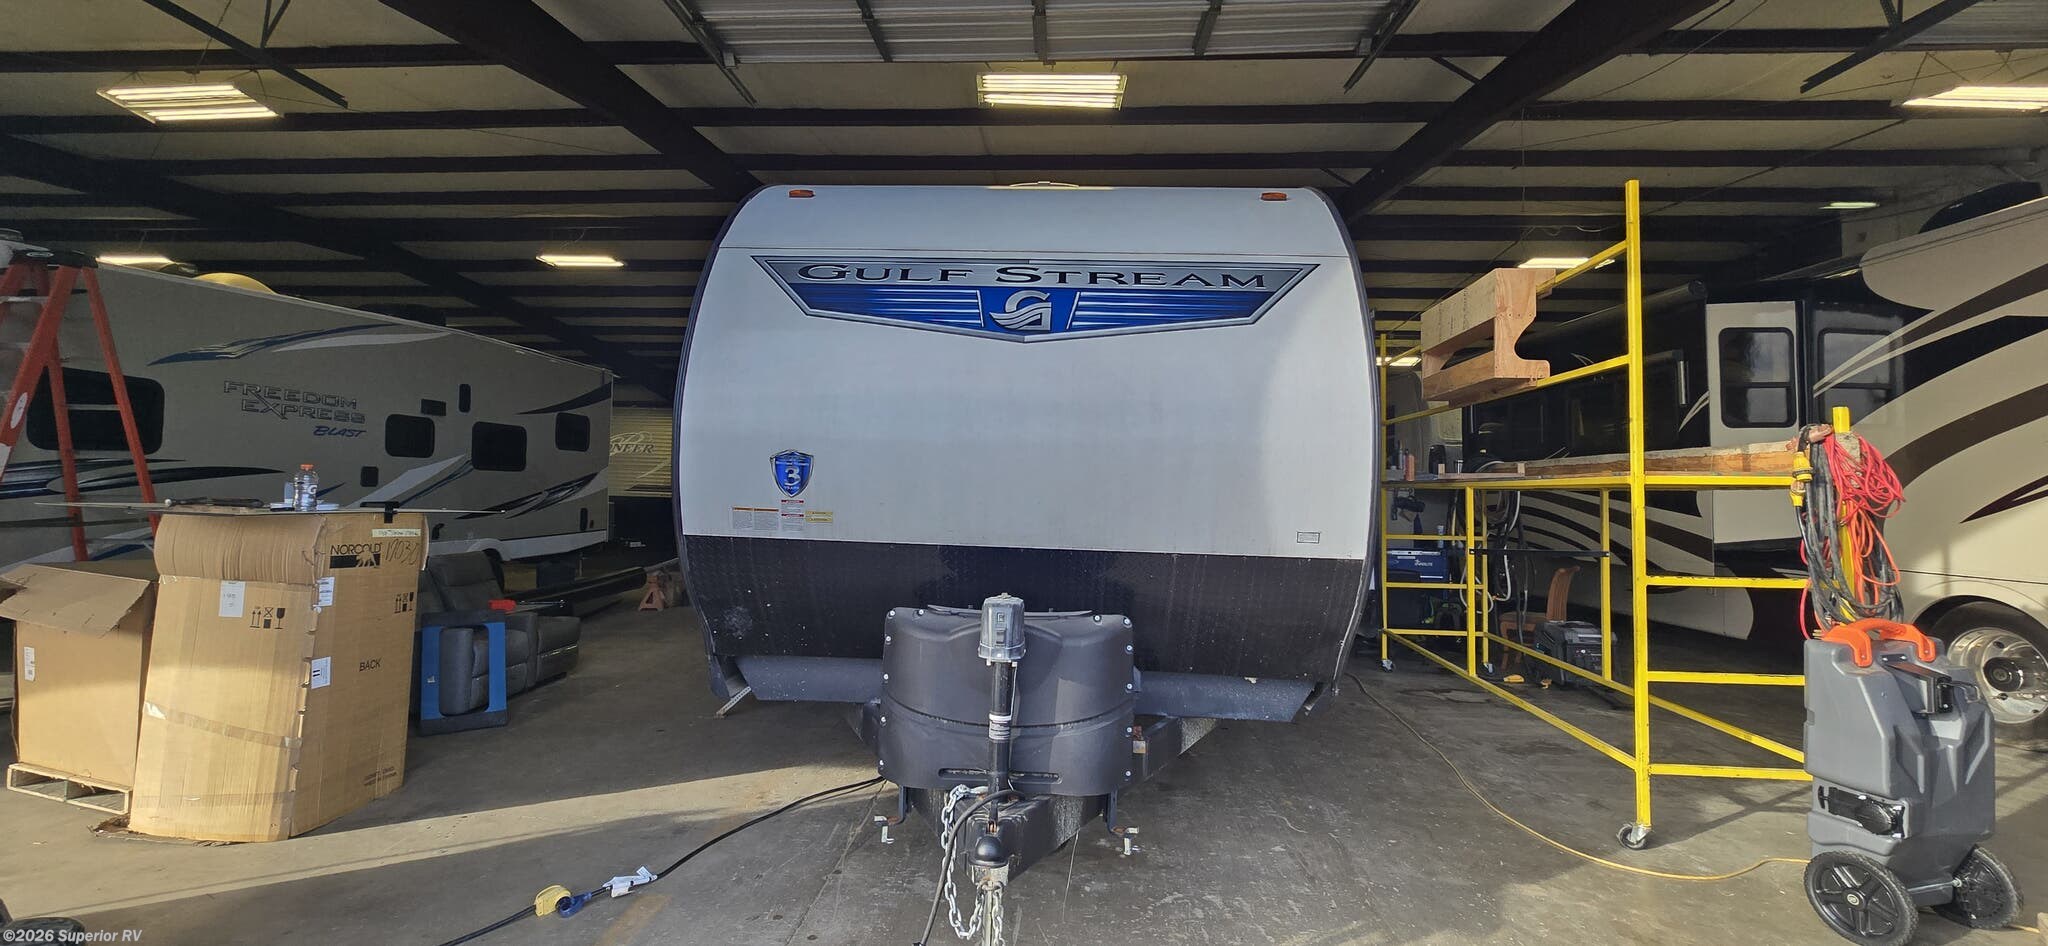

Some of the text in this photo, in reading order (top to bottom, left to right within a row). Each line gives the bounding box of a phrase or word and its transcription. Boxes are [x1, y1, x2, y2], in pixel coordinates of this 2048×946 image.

[798, 264, 1264, 288] GULF STREAM
[223, 380, 357, 410] FREEDOM
[241, 399, 366, 424] EXPRESS
[313, 425, 367, 438] BLAST
[785, 465, 801, 486] 3
[330, 543, 382, 555] NORCOLD
[359, 659, 382, 672] BACK
